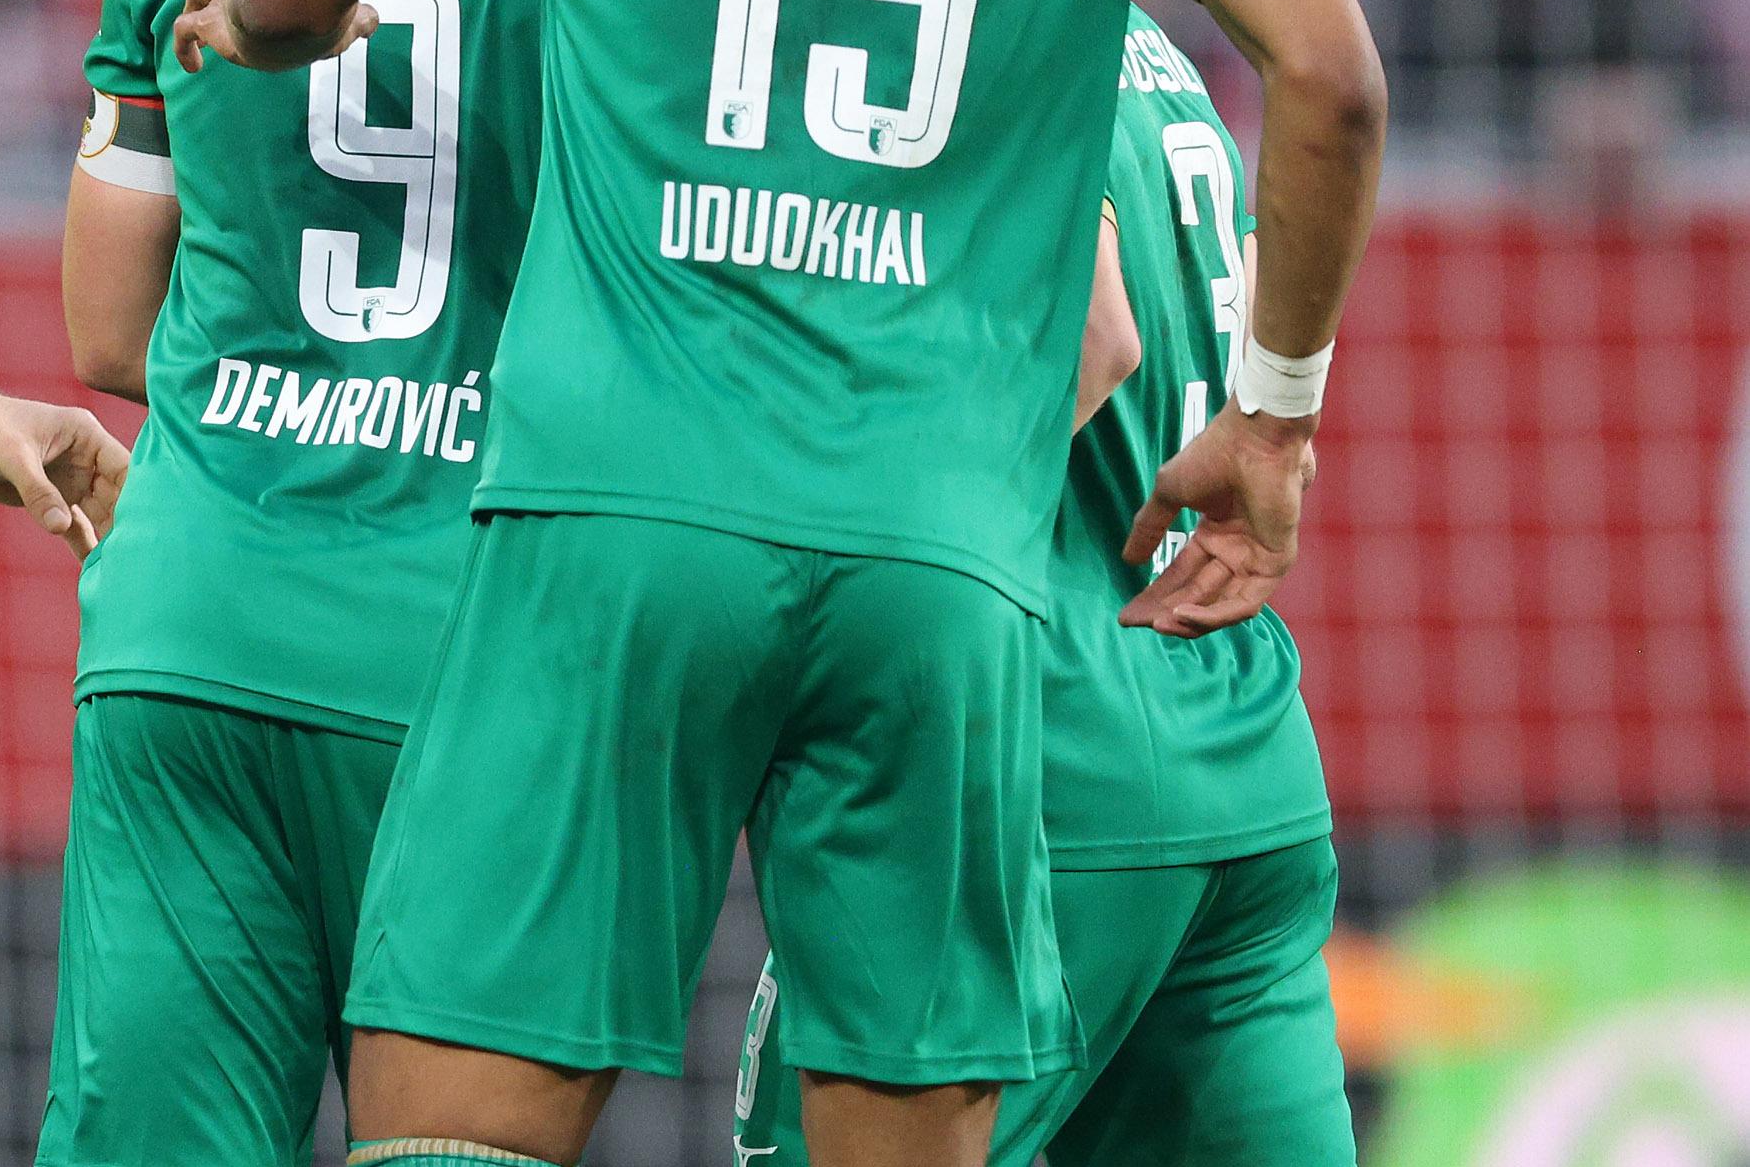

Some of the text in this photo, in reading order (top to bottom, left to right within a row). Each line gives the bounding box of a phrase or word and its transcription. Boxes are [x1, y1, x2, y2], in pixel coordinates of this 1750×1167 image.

[659, 181, 927, 286] UDUOKHAI
[1162, 121, 1247, 454] 3
[200, 357, 483, 463] DEMIROVIĆ
